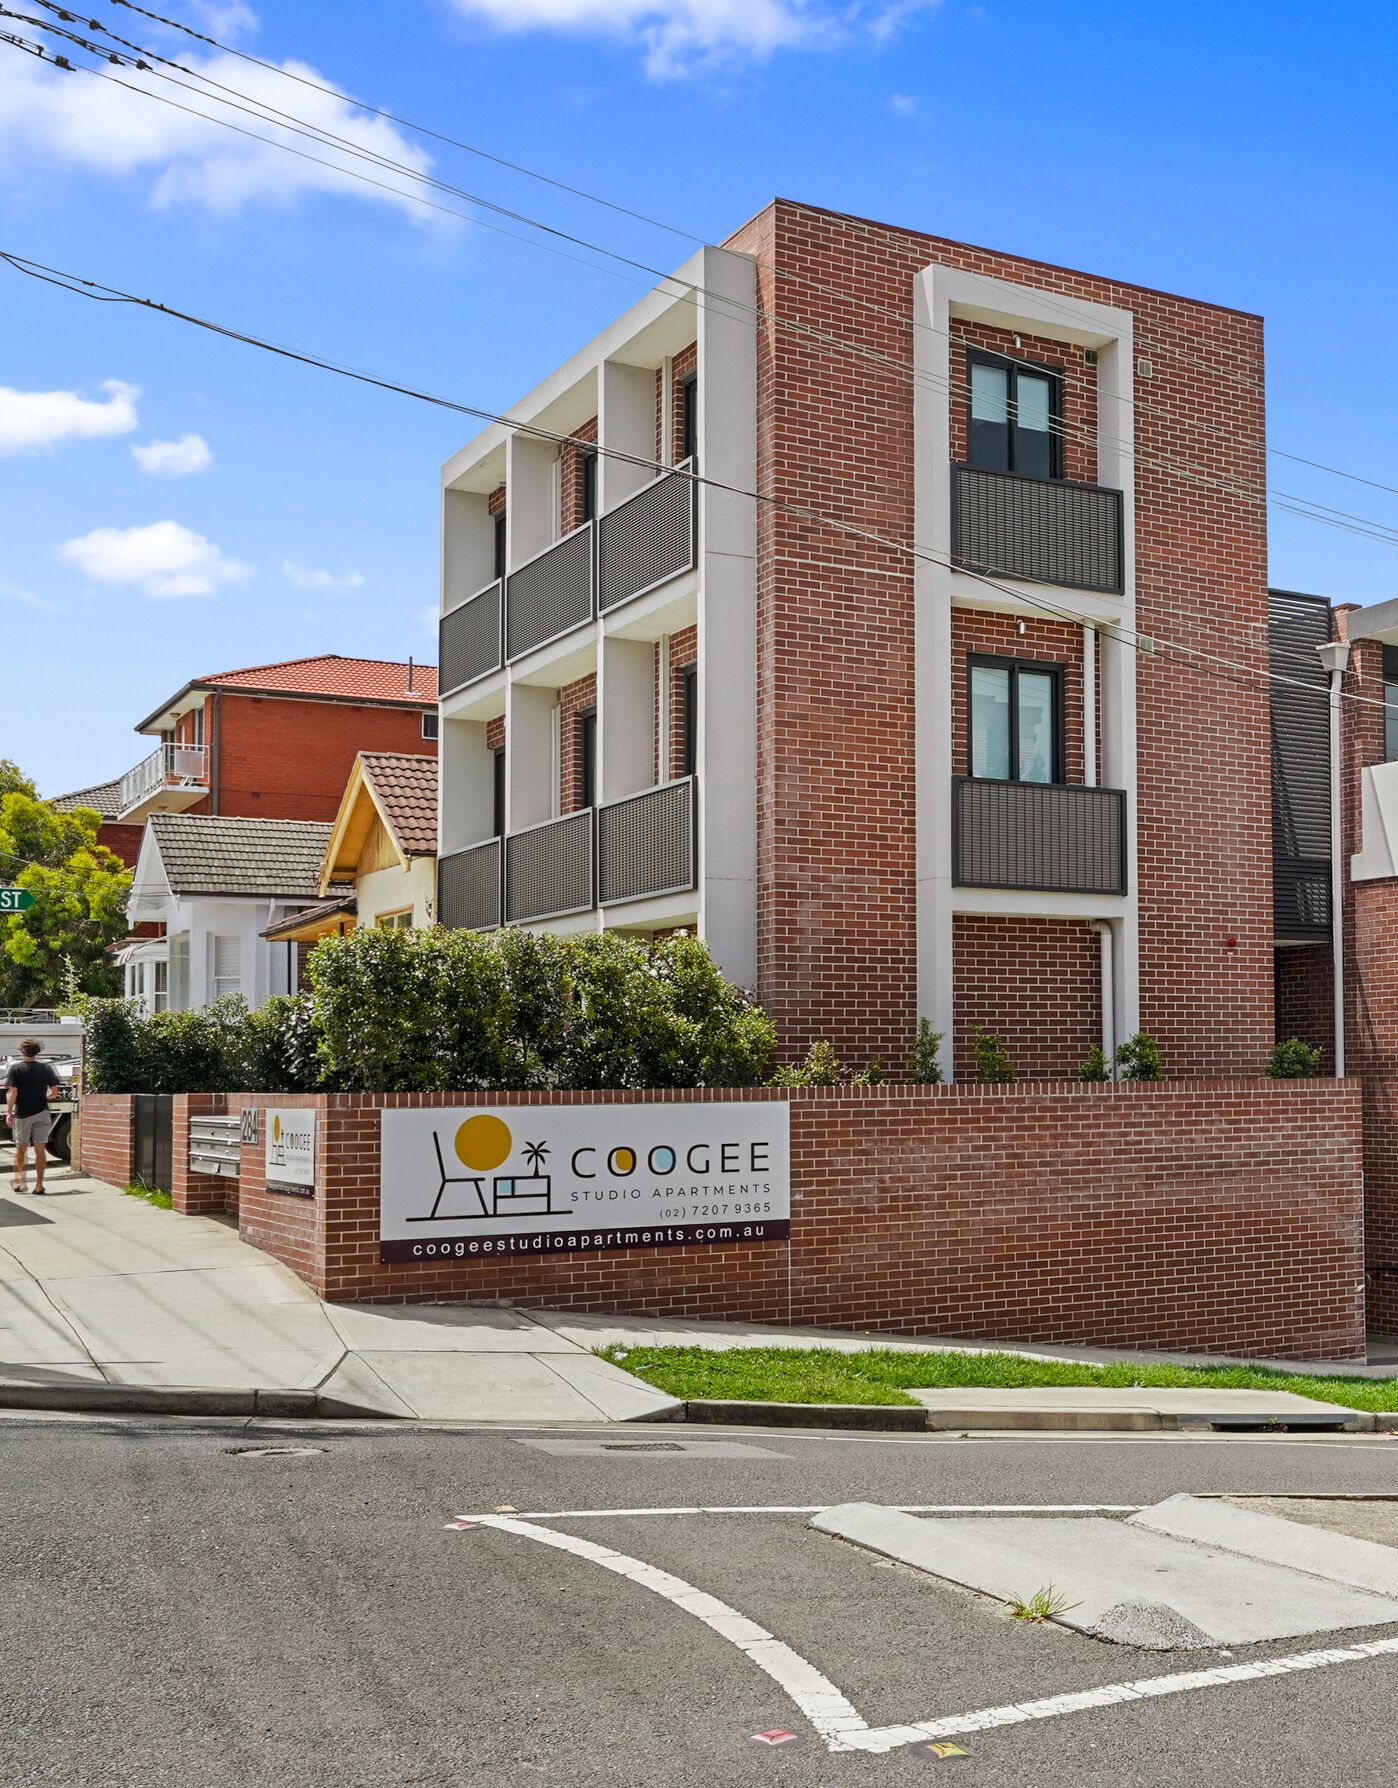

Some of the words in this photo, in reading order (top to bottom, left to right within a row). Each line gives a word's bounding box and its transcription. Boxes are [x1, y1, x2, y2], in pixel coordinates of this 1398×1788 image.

[1, 891, 22, 908] ST
[242, 1110, 257, 1142] 284
[285, 1132, 311, 1151] COOGEE
[571, 1142, 770, 1178] COOGEE
[571, 1189, 641, 1202] STUDIO
[652, 1183, 771, 1198] APARTMENTS
[659, 1206, 686, 1219] (02)
[692, 1204, 728, 1216] 7207
[734, 1202, 771, 1214] 9365
[413, 1224, 765, 1257] coogeestudioapartments.com.au
